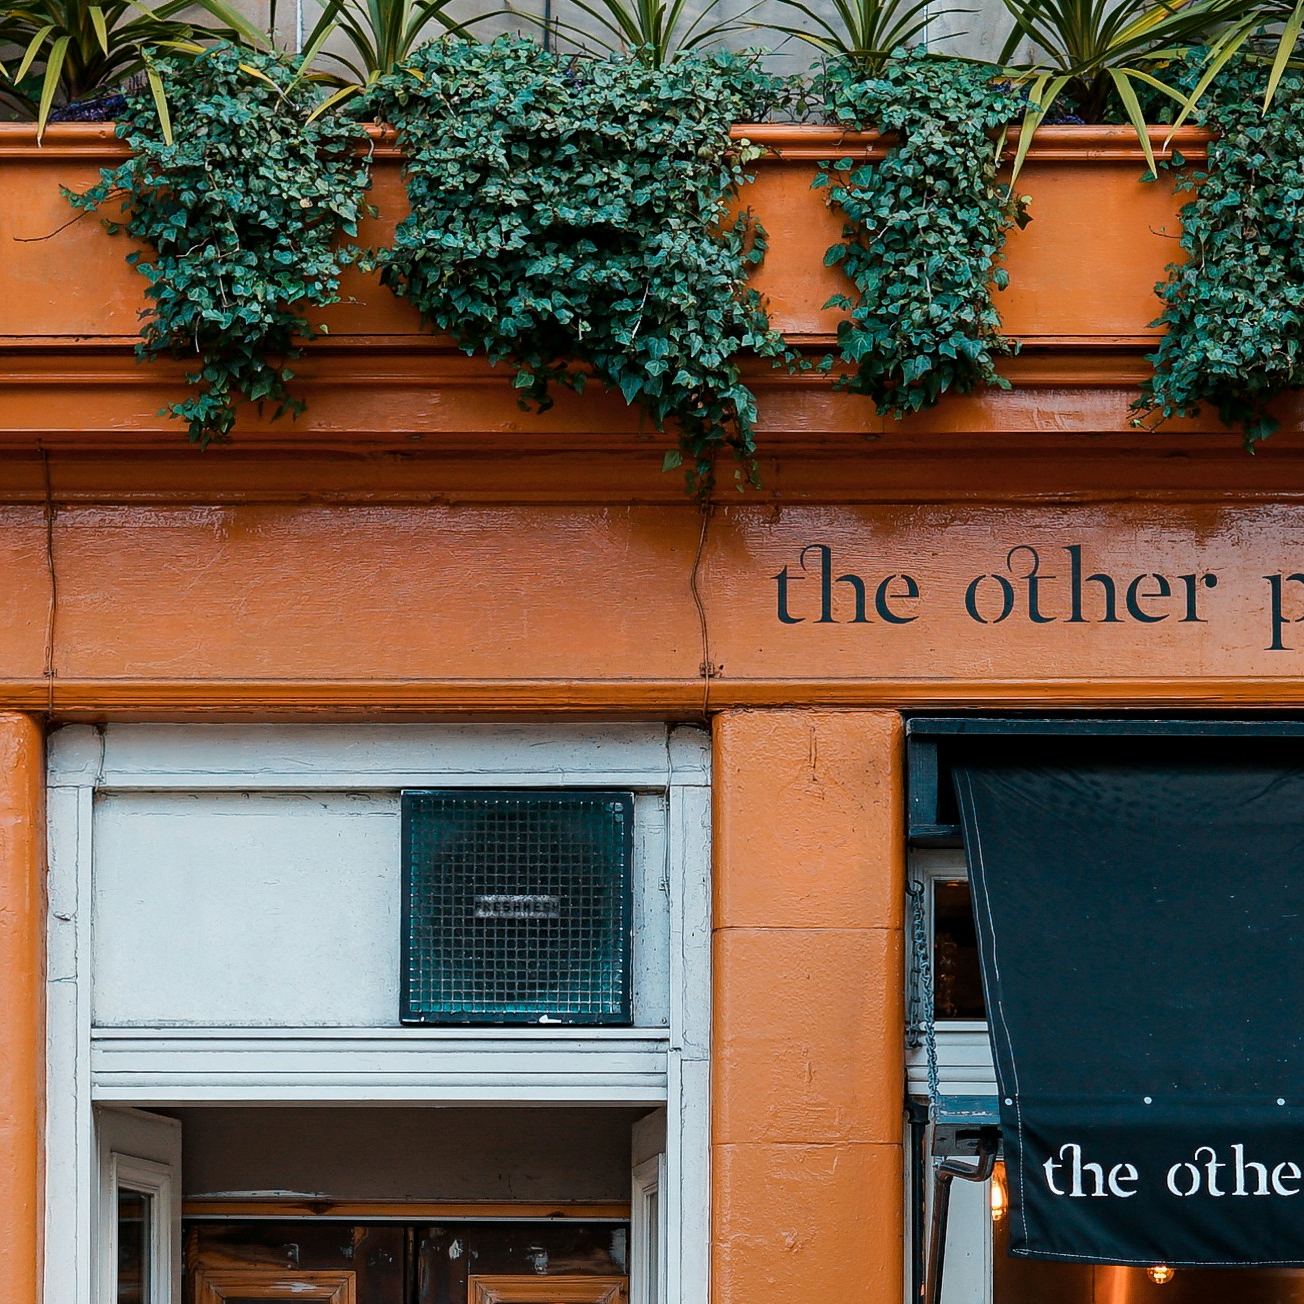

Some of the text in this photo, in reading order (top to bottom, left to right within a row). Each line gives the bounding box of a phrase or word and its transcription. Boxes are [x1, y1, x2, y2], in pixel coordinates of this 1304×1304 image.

[770, 543, 920, 624] the
[965, 544, 1218, 624] other
[1042, 1143, 1139, 1197] the
